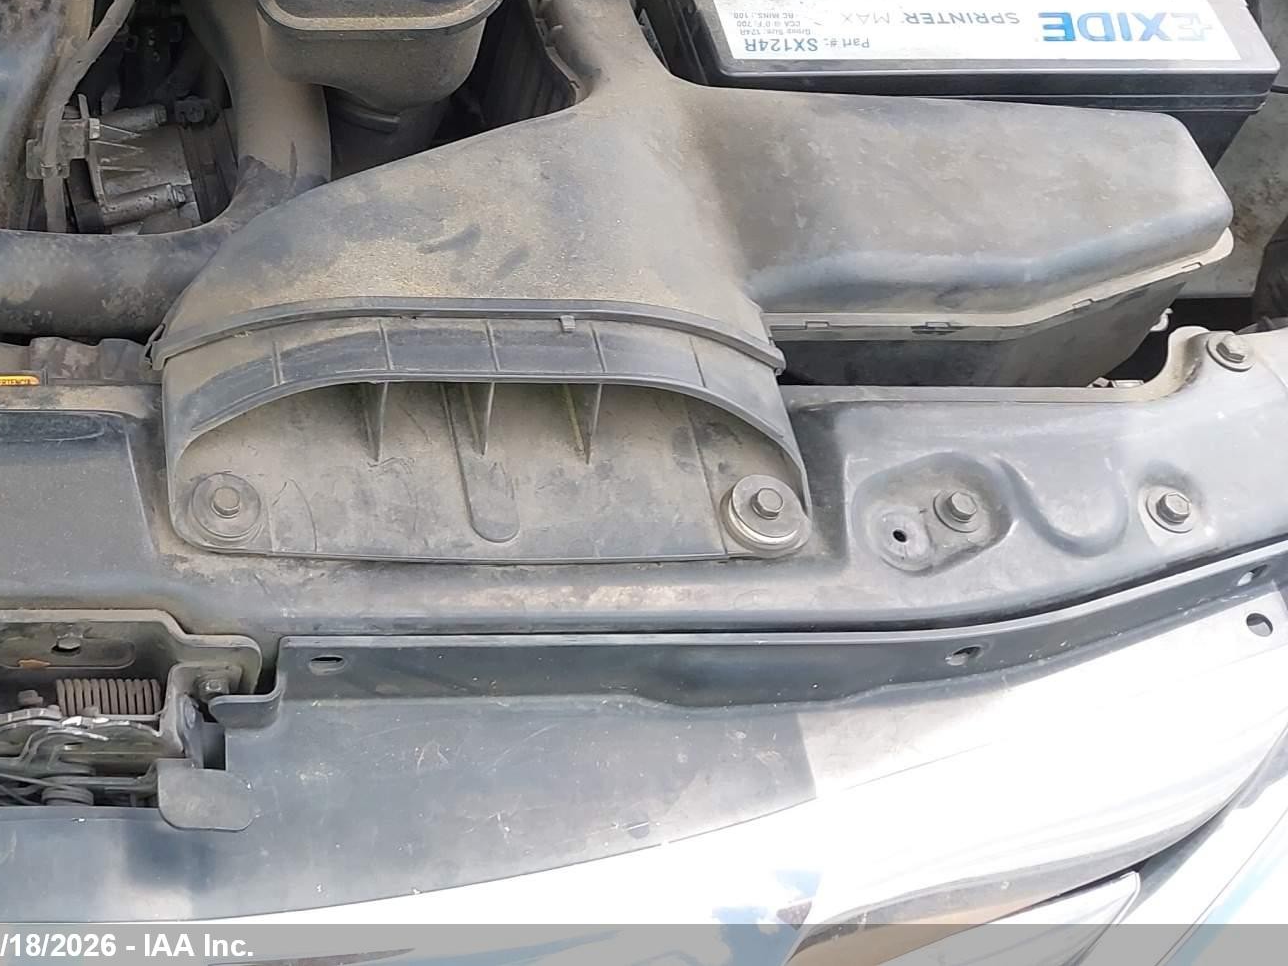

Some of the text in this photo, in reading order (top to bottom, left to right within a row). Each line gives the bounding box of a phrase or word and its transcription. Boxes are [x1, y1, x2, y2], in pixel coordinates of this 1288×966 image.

[840, 12, 1020, 24] SPRINTER MAX
[1038, 12, 1213, 42] EXIDE
[744, 38, 818, 51] SX124R
[843, 38, 870, 48] Part
